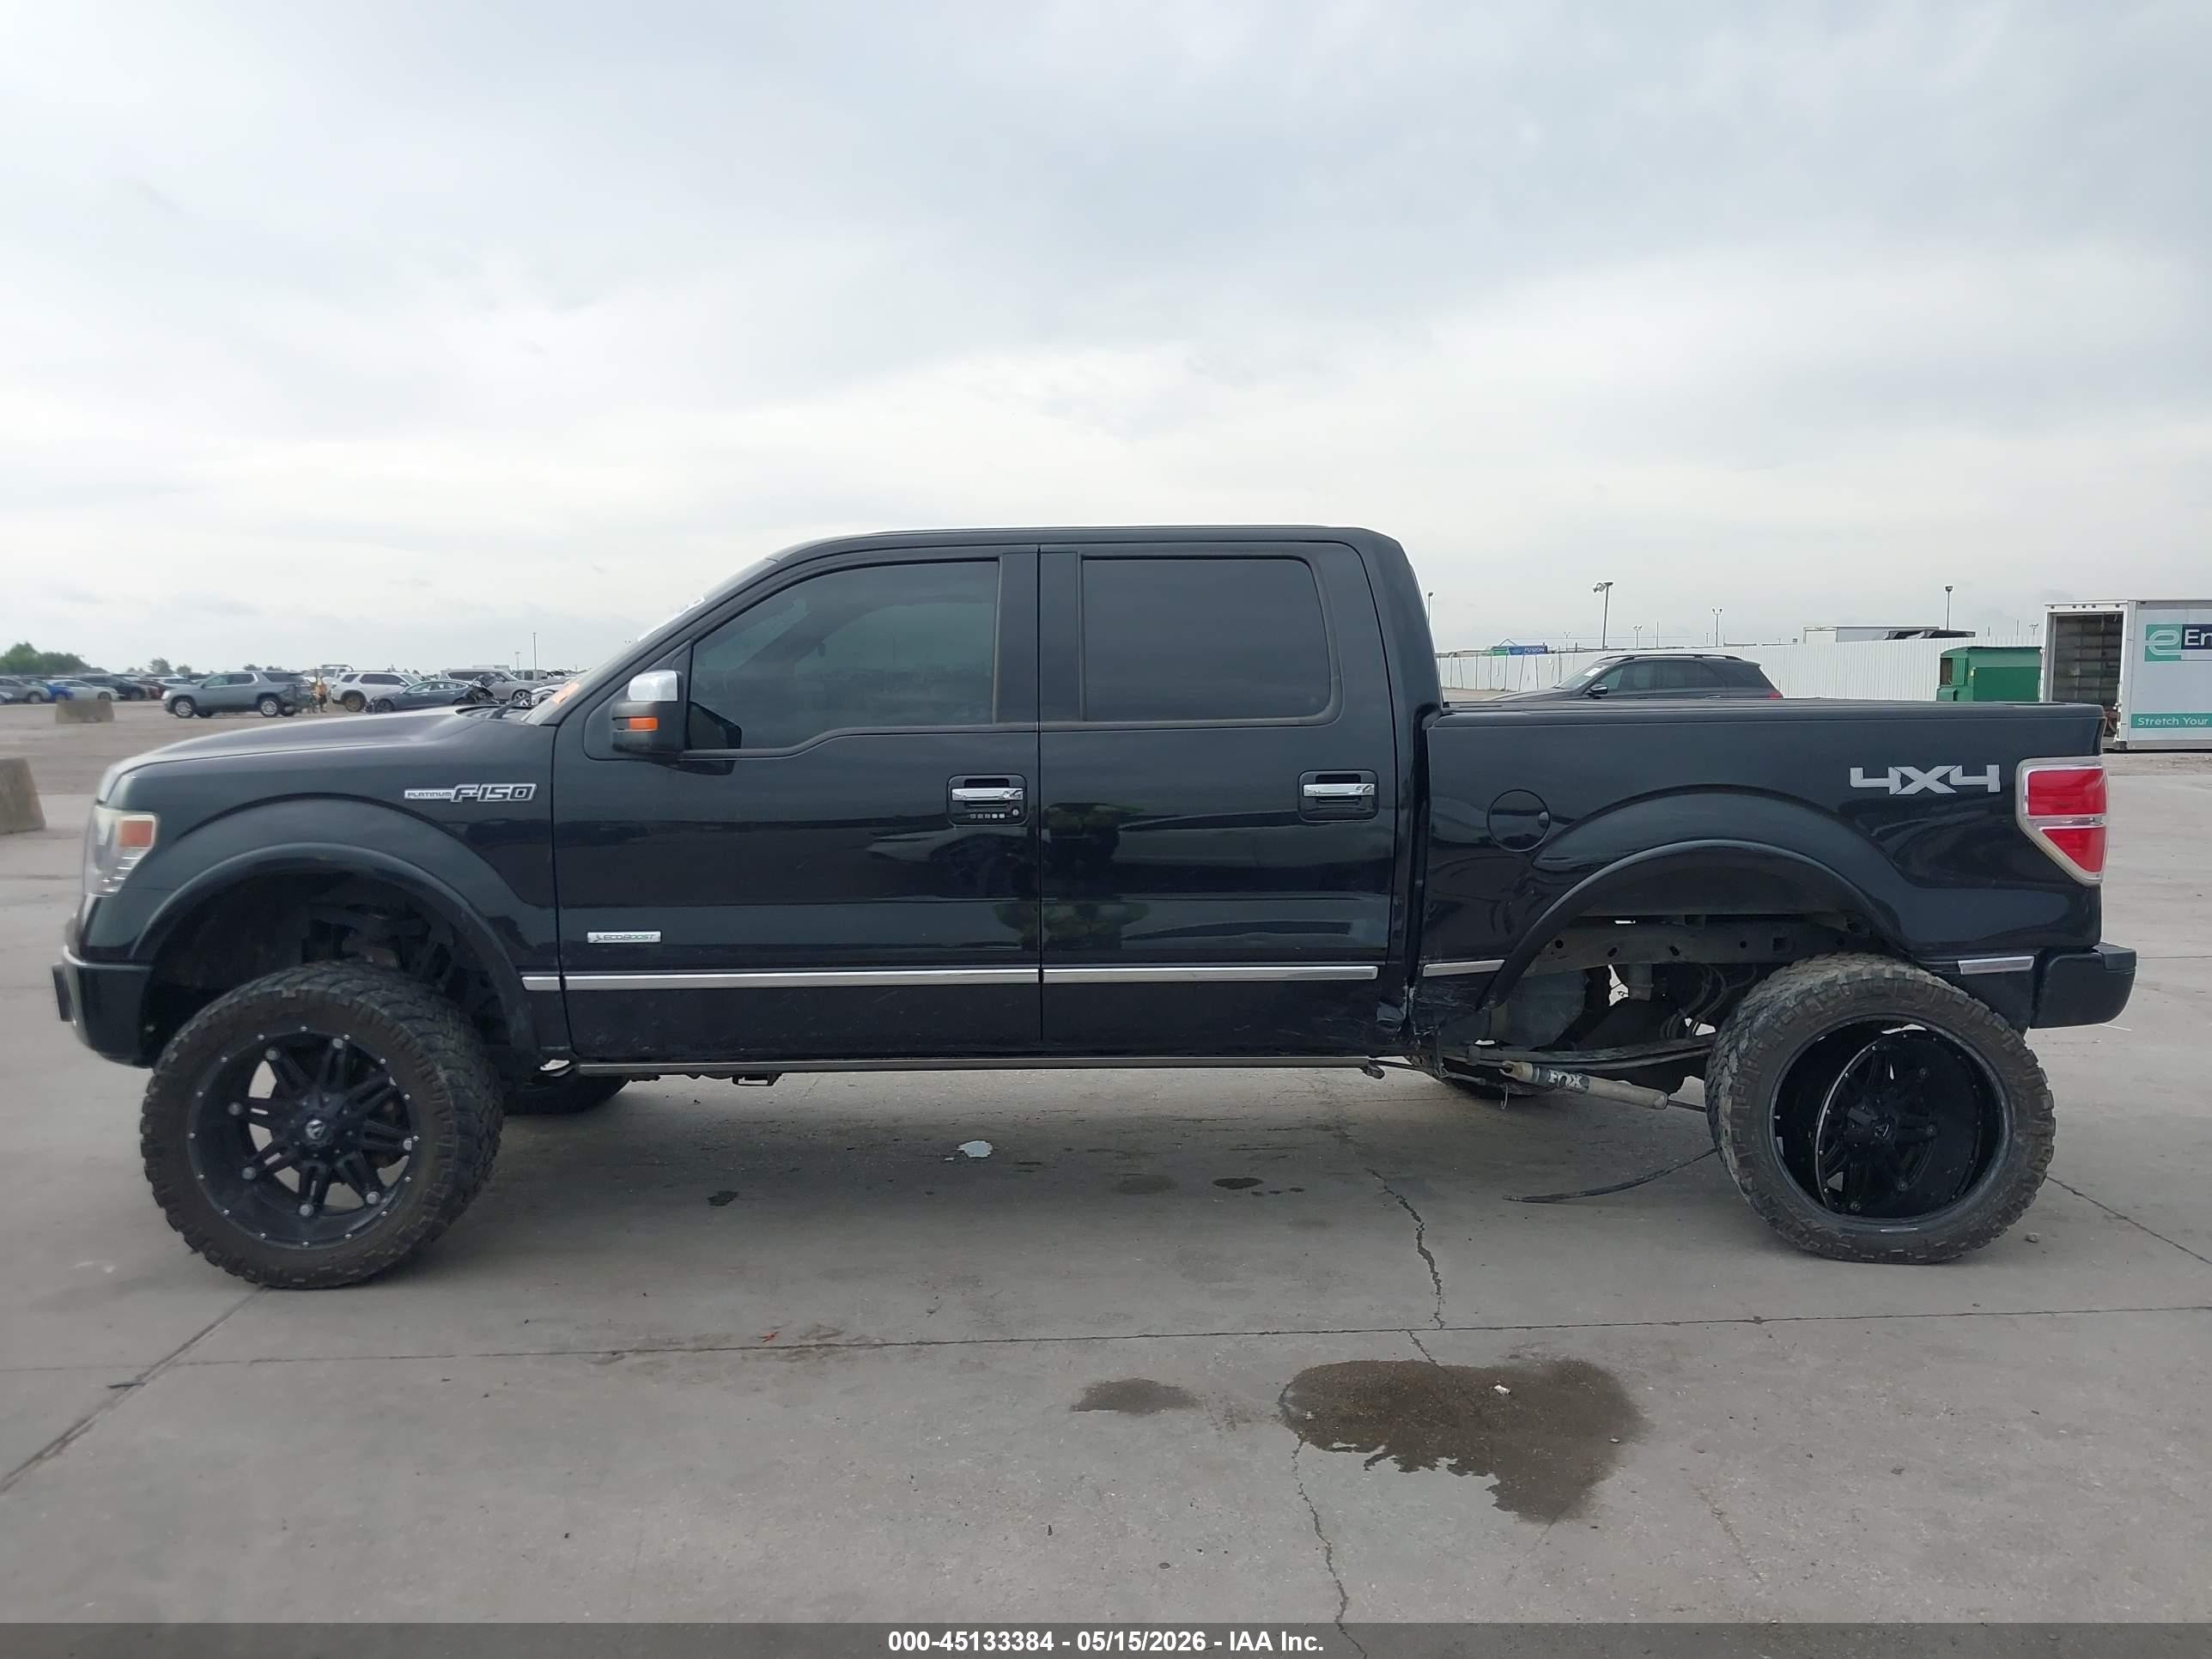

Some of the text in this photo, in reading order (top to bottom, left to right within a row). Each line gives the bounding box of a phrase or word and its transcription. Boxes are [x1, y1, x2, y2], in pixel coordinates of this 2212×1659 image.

[2137, 717, 2209, 726] Stretch Your
[452, 783, 537, 803] F-150
